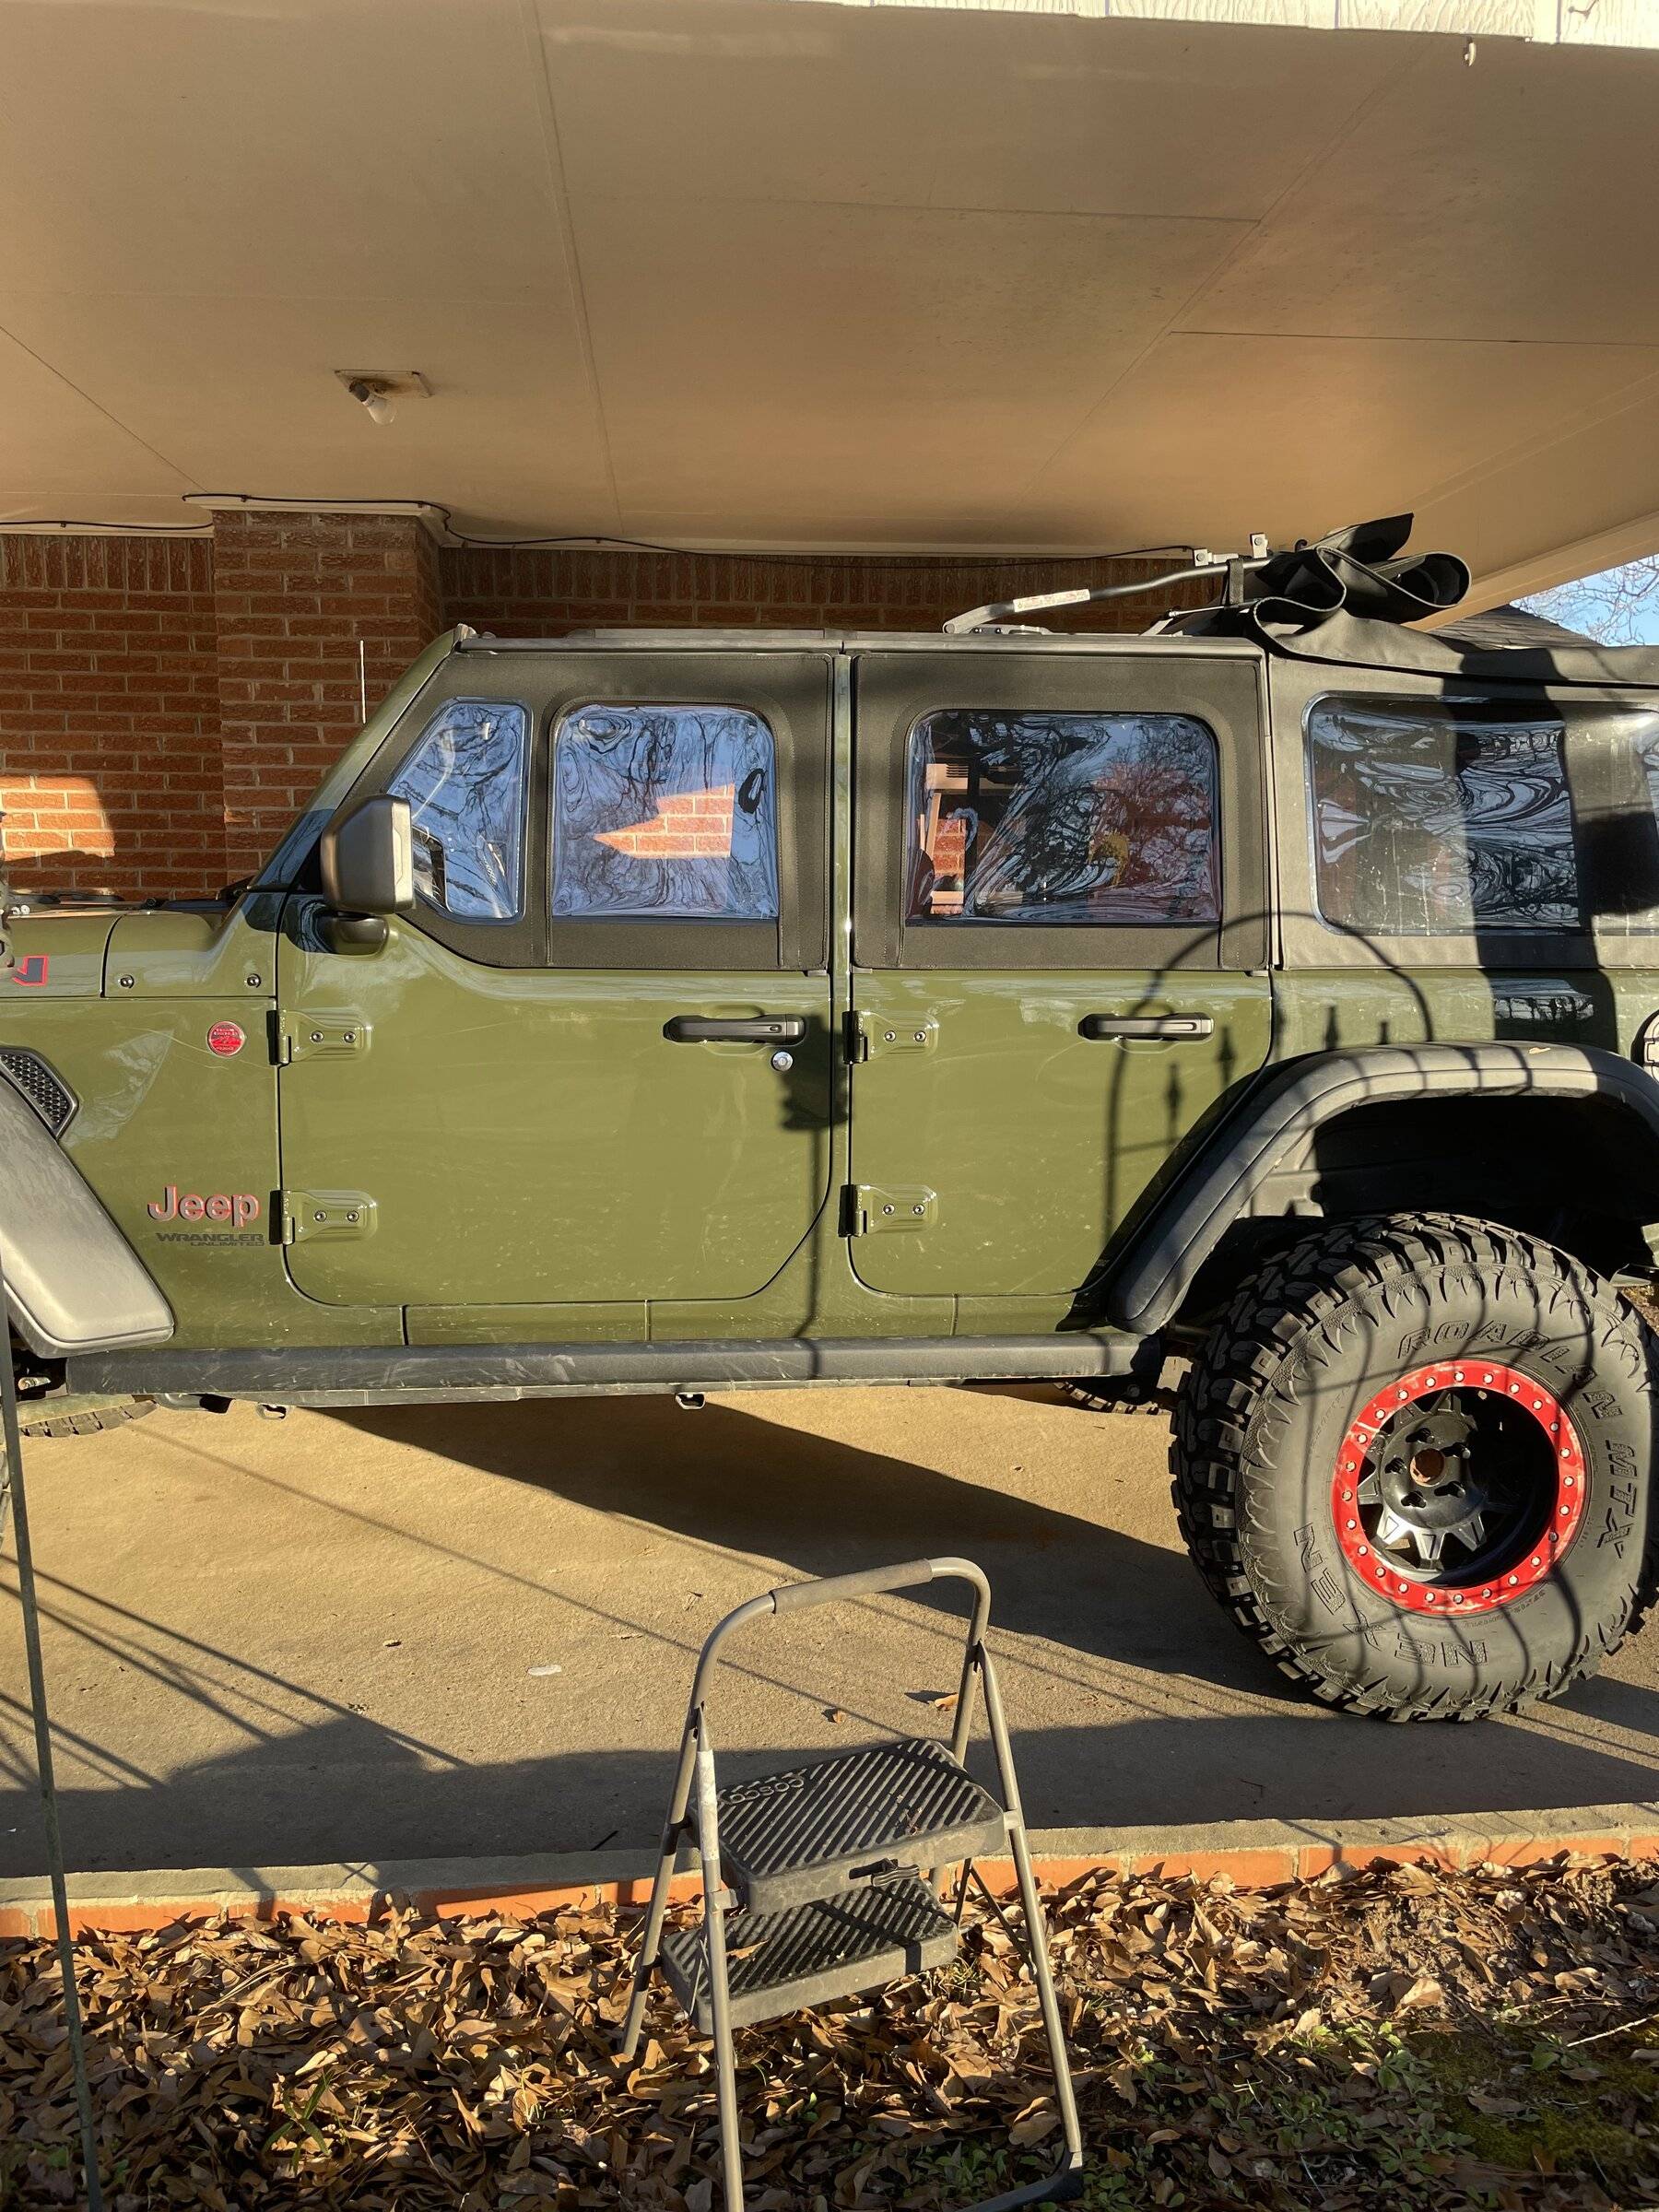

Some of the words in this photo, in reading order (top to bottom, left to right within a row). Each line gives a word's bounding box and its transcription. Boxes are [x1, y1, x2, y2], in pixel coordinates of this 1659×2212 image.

[147, 1184, 260, 1228] Jeep
[156, 1232, 264, 1242] WRANGLER
[1397, 1320, 1623, 1419] ROADIAN
[1597, 1439, 1638, 1559] MTX
[1293, 1522, 1488, 1667] NEXEN
[729, 1778, 805, 1804] COSCO
